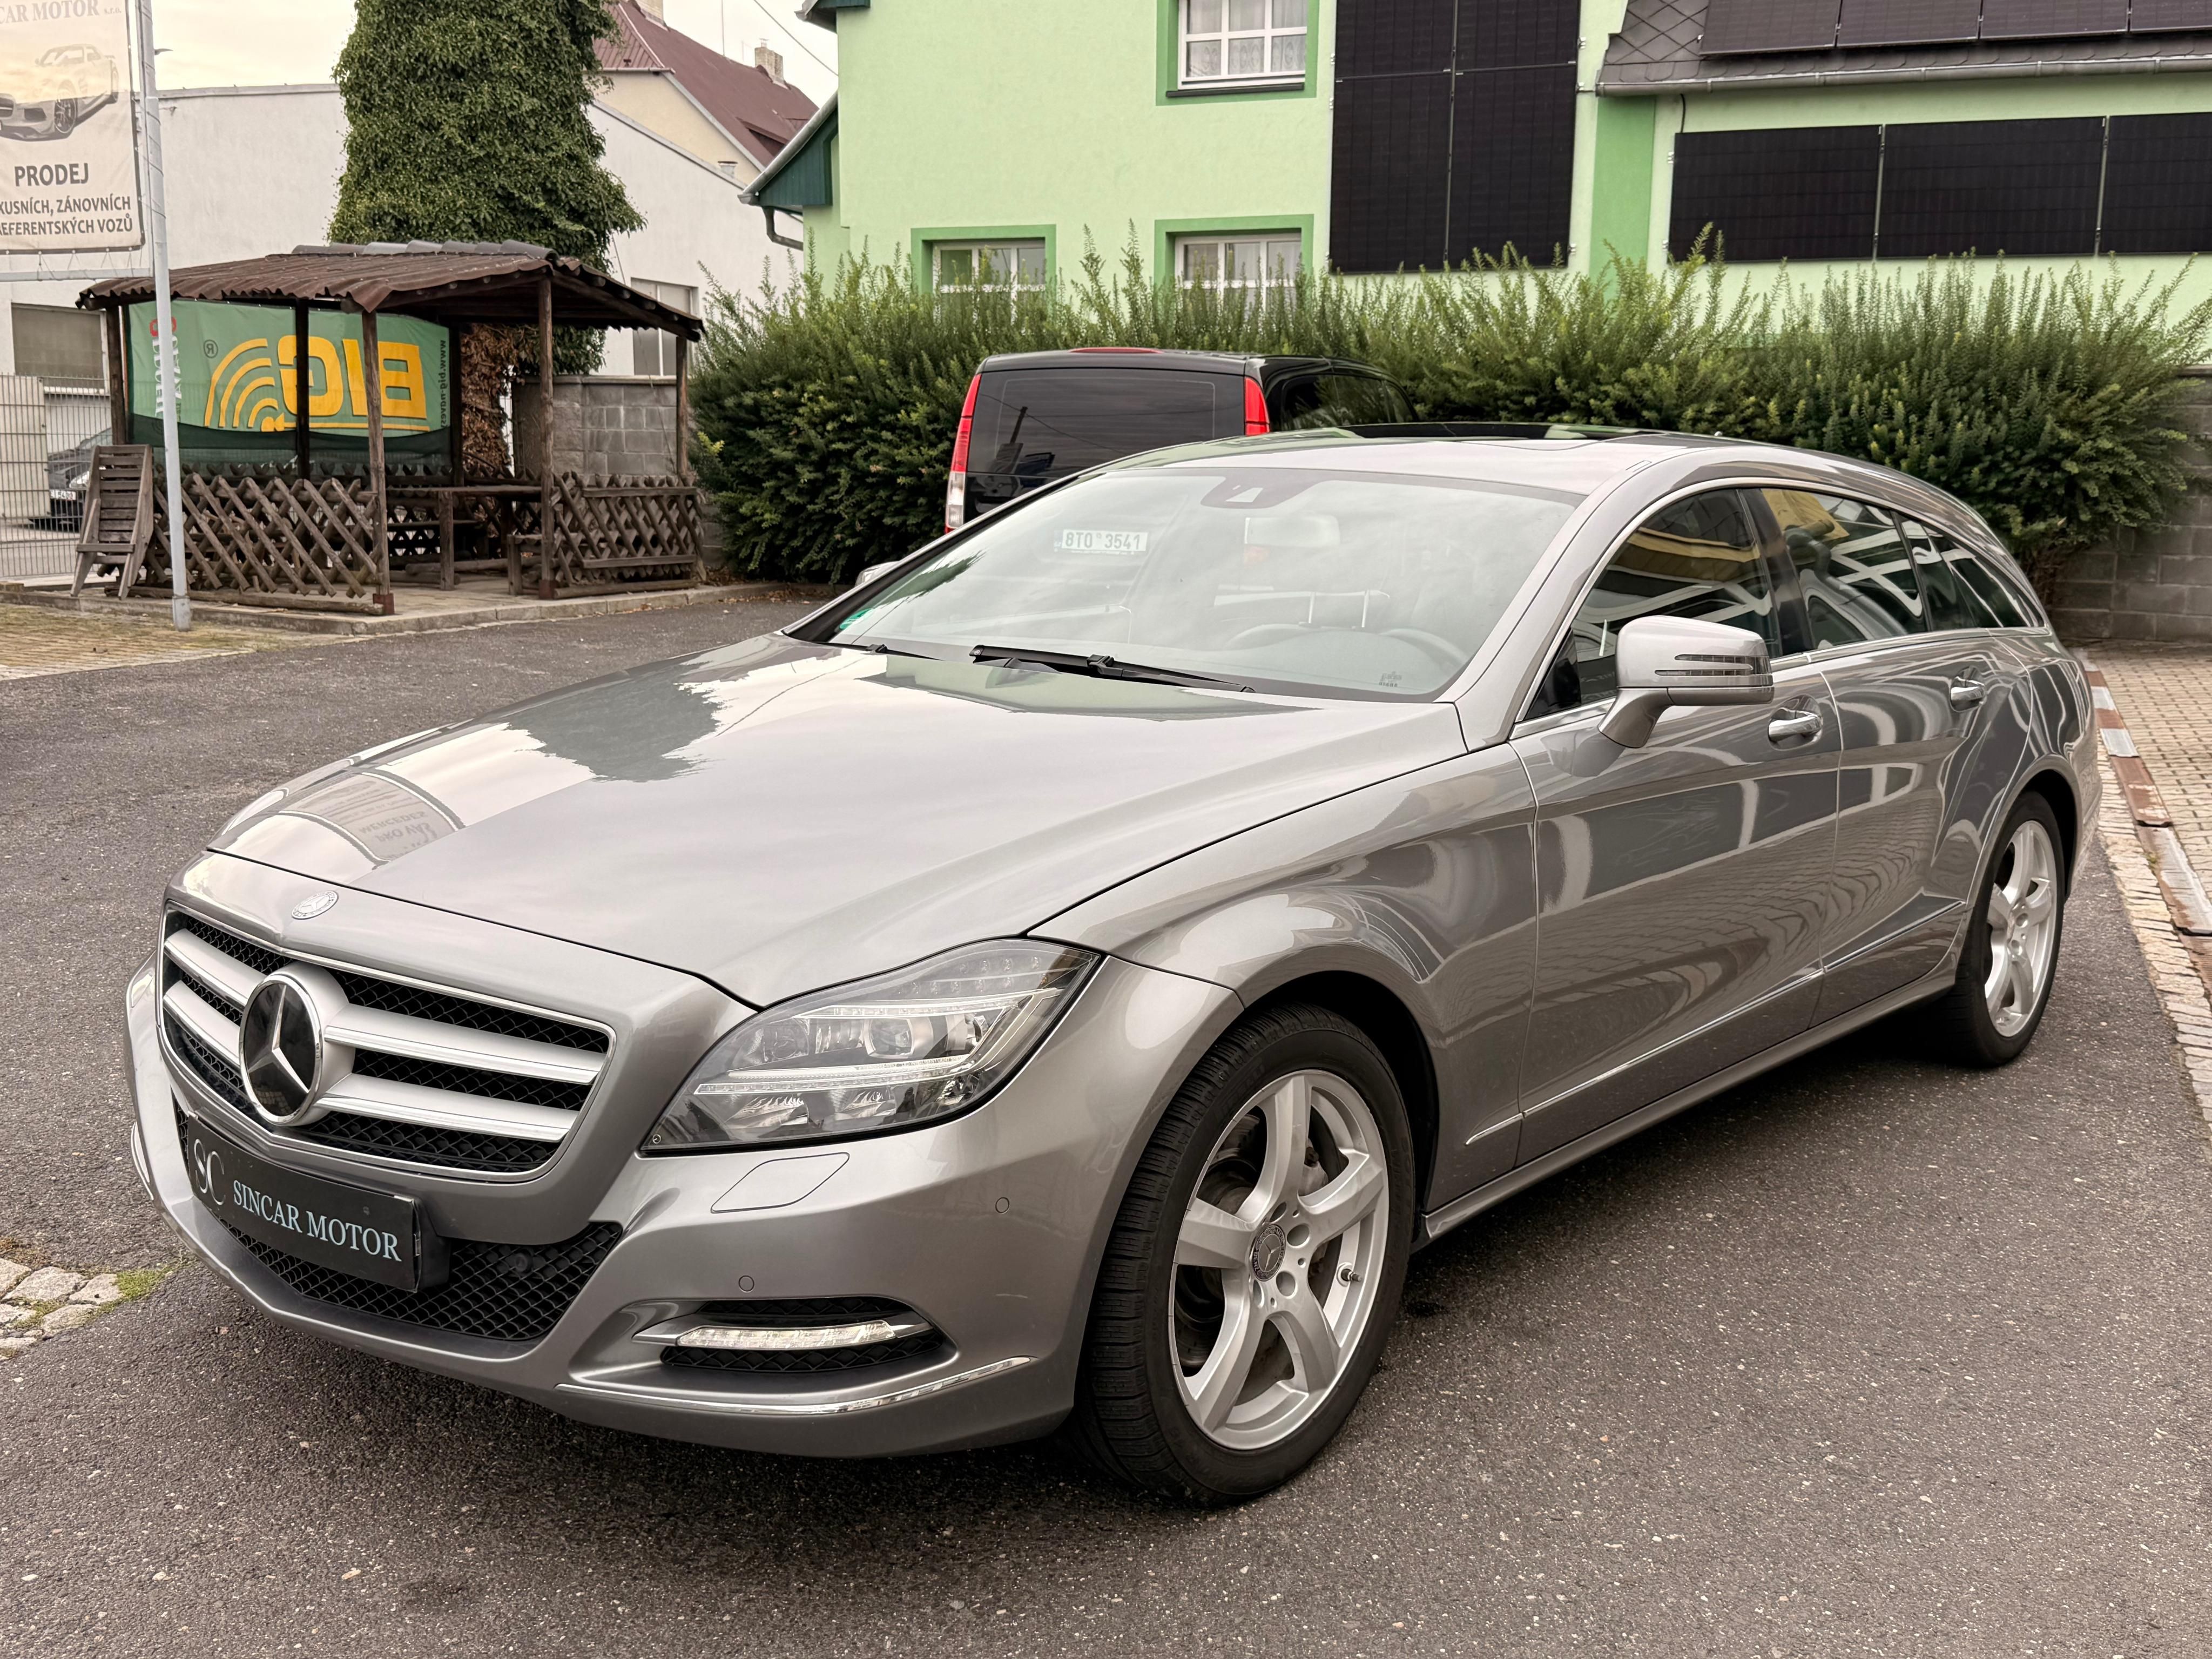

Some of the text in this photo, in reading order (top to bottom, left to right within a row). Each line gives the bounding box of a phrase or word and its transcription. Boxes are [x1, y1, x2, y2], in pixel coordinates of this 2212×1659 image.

[32, 0, 100, 21] MOTOR
[15, 163, 89, 187] PRODEJ
[57, 193, 131, 213] ZÁNOVNÍCH
[97, 213, 133, 233] VOZŮ
[1104, 534, 1141, 550] 3541
[194, 1138, 225, 1205] SC
[233, 1180, 402, 1262] SINCAR MOTOR
